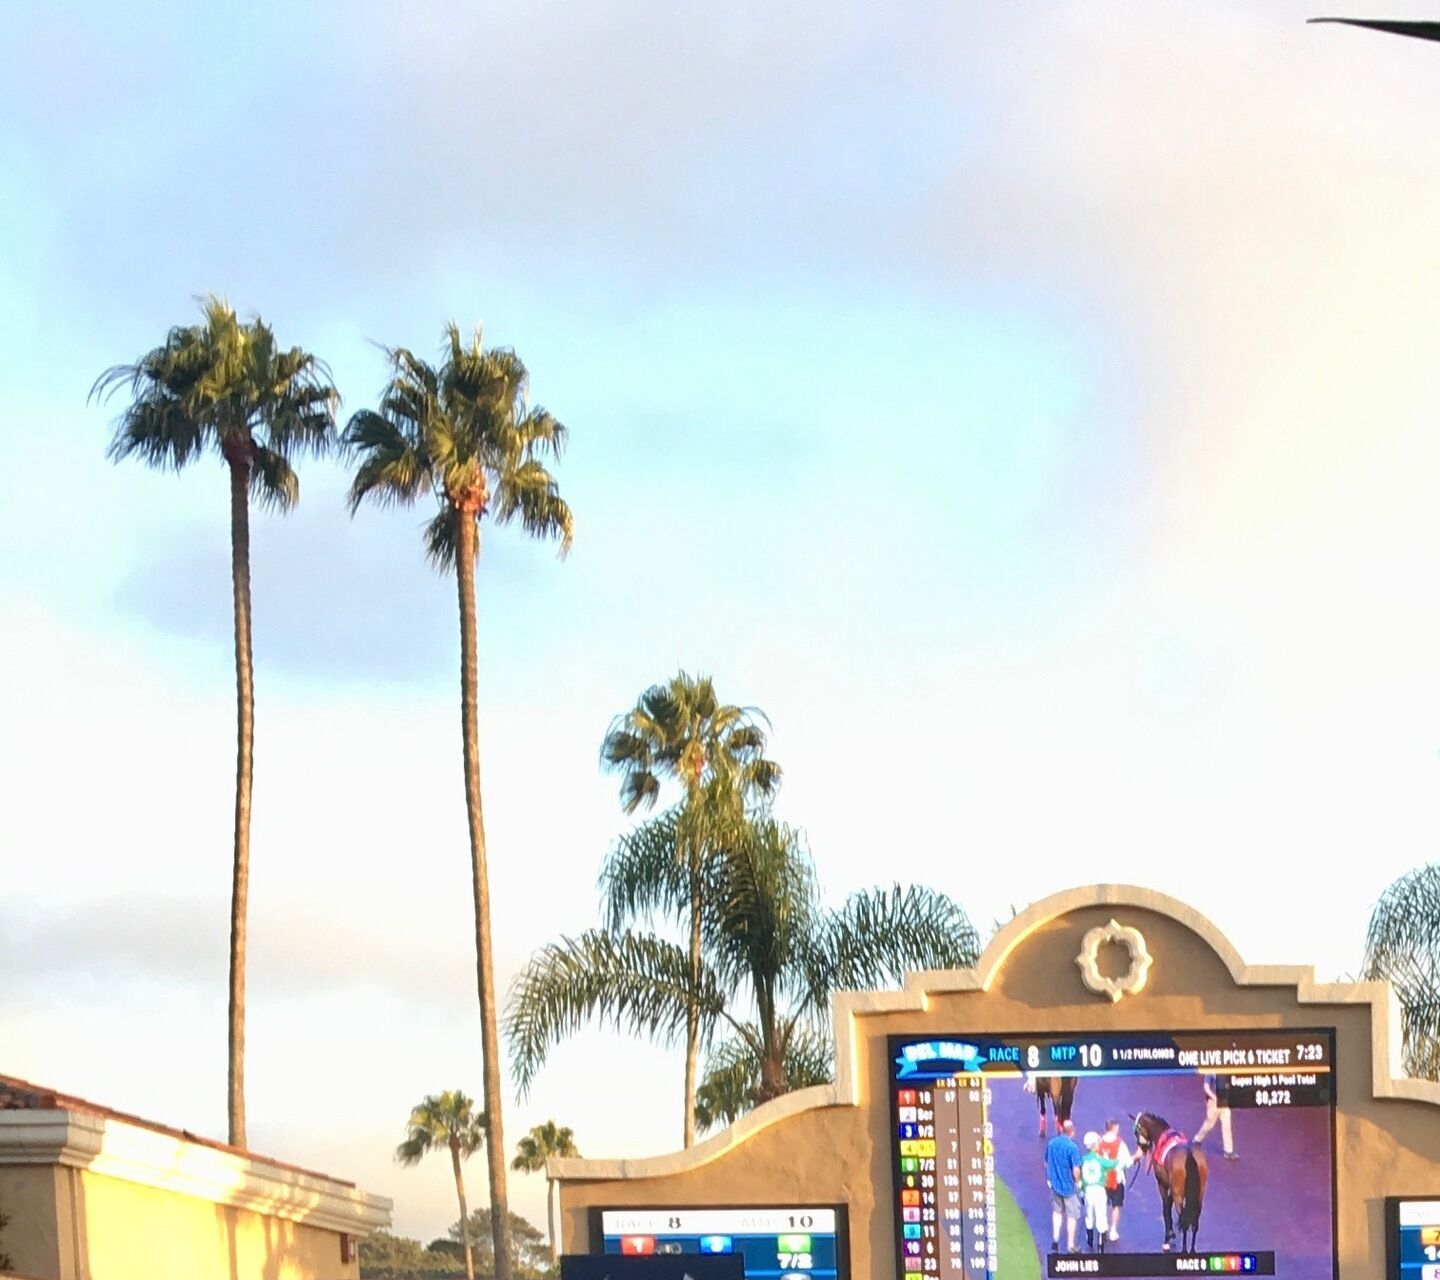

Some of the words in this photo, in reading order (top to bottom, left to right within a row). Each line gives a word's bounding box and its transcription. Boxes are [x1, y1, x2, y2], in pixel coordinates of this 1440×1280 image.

[989, 1048, 1019, 1061] RACE
[1027, 1045, 1040, 1068] 8
[1051, 1046, 1076, 1060] MTP
[1079, 1044, 1102, 1067] 10
[1133, 1048, 1175, 1060] FURLONGS
[1179, 1050, 1198, 1066] ONE
[1201, 1050, 1222, 1066] LIVE
[1224, 1050, 1246, 1065] PICK
[1248, 1050, 1255, 1064] 6
[1256, 1049, 1290, 1064] TICKET
[1297, 1045, 1322, 1061] 7:23
[905, 1125, 912, 1137] 3
[922, 1192, 935, 1204] 14
[668, 1216, 682, 1229] 8
[786, 1216, 813, 1229] 10
[923, 1225, 935, 1238] 11
[777, 1253, 813, 1269] 7/2
